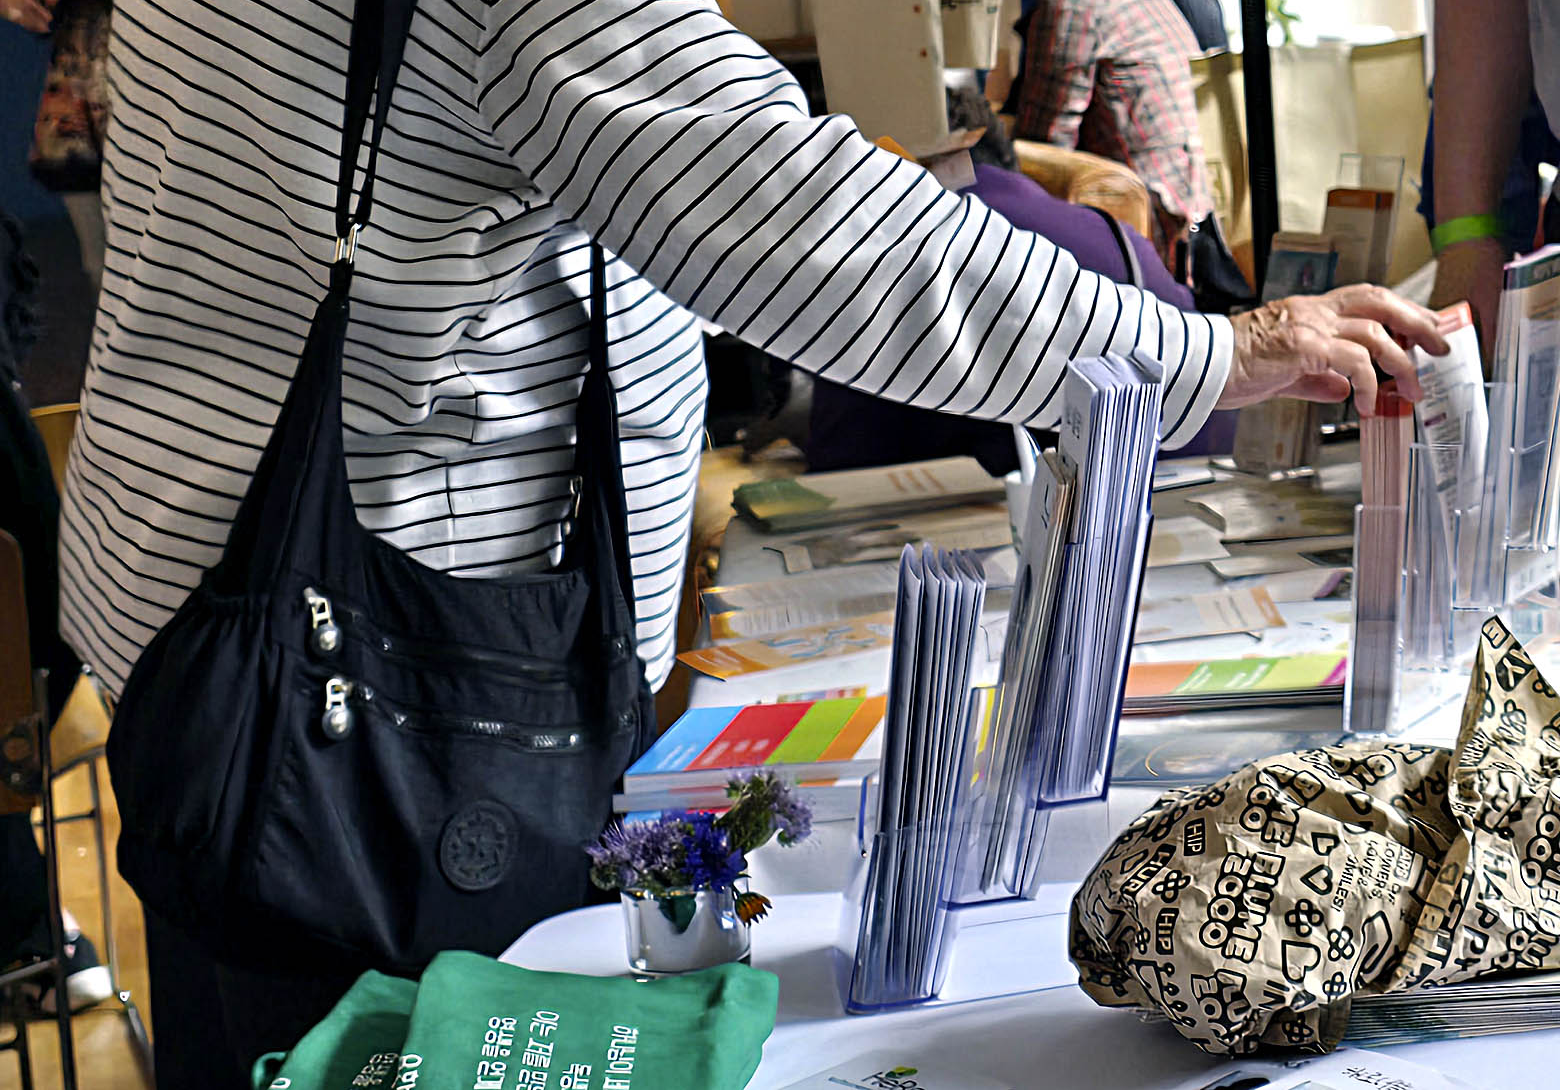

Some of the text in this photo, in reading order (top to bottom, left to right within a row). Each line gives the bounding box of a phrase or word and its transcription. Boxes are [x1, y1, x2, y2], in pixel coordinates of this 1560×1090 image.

[1186, 821, 1204, 854] HIP
[1199, 852, 1251, 949] 2000
[1221, 852, 1286, 964] BLUME
[1157, 910, 1173, 952] HIP
[481, 1016, 518, 1058] 영생을
